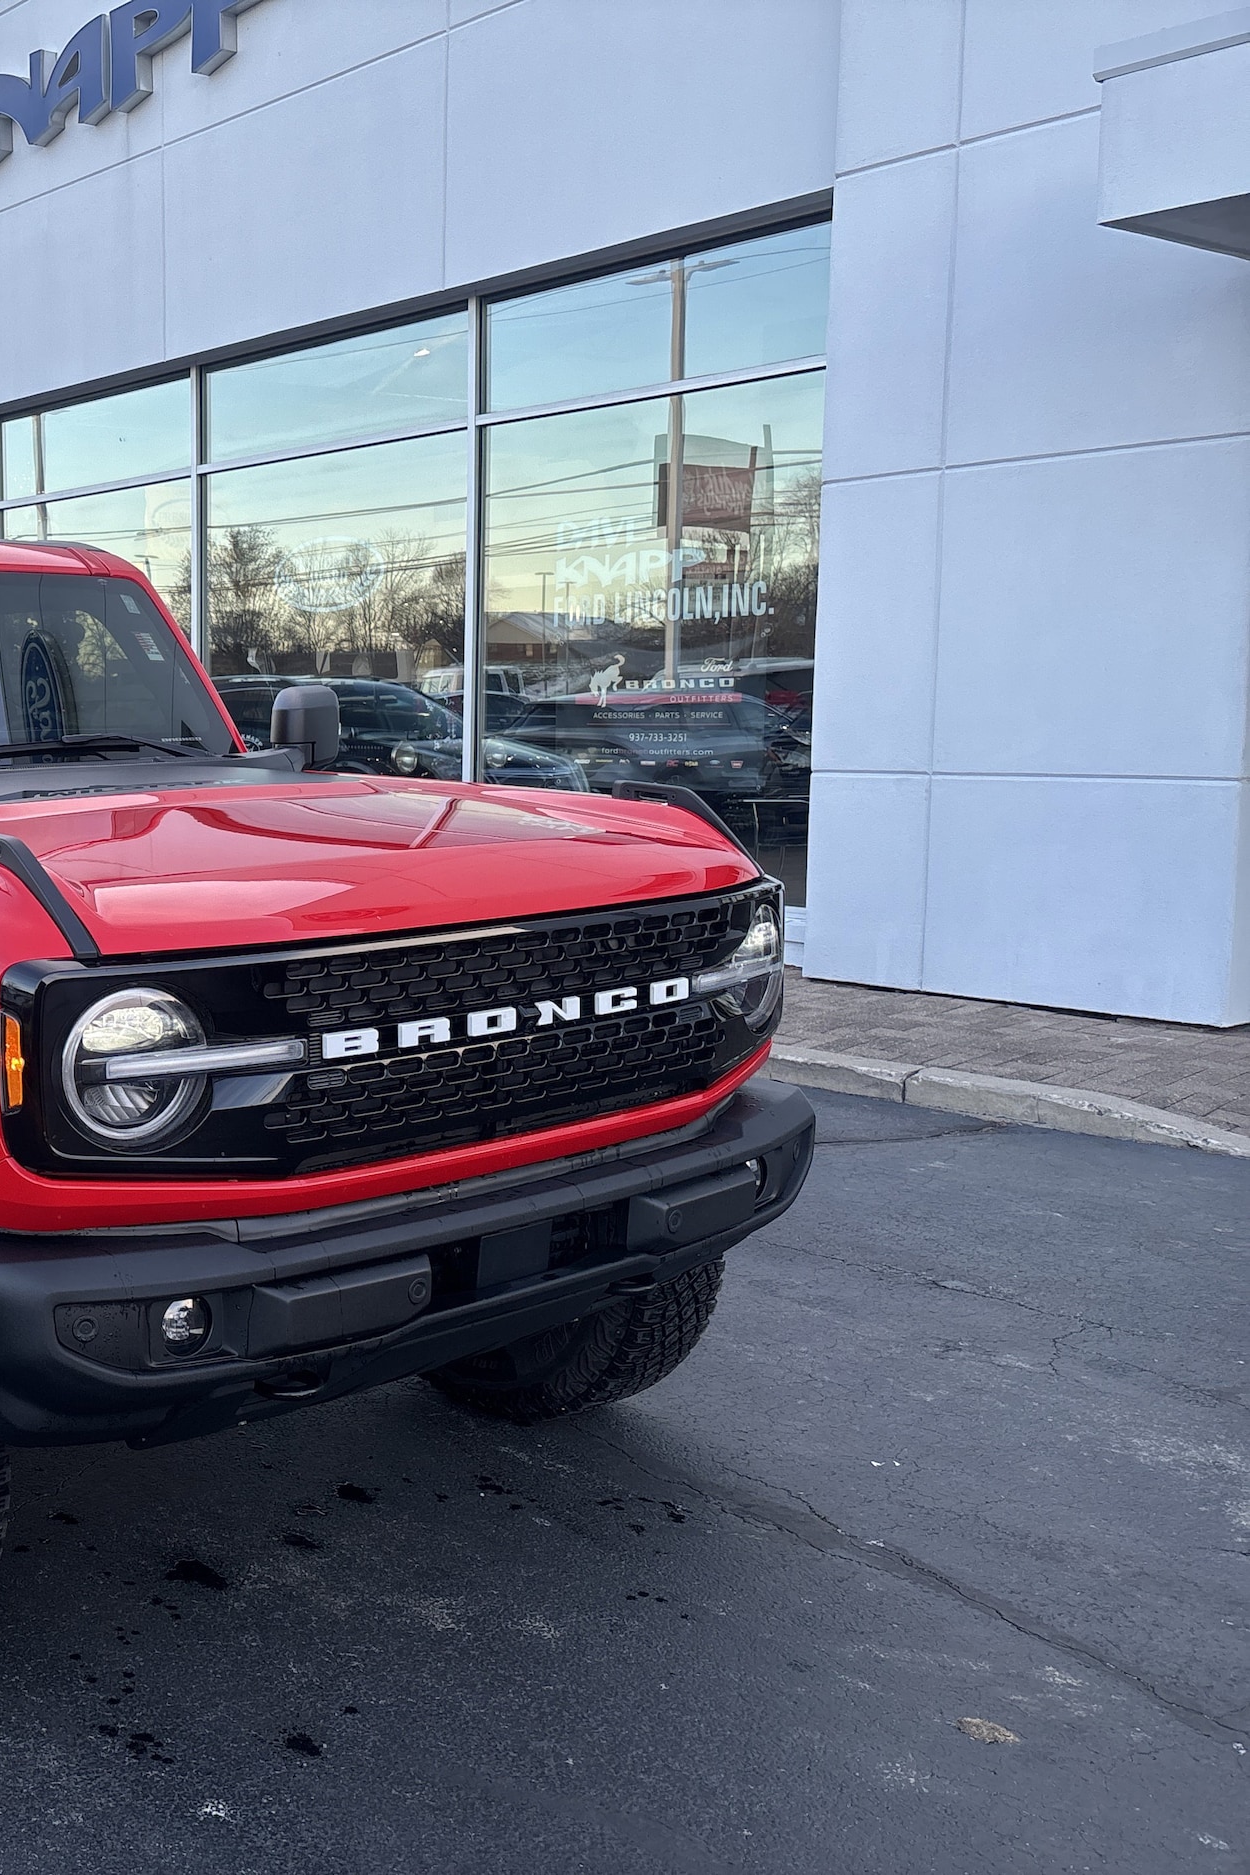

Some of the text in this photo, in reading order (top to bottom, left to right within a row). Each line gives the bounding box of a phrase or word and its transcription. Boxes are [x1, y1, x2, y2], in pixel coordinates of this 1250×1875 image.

[556, 548, 706, 590] KNAPP
[553, 593, 606, 628] FORD
[701, 657, 734, 673] Ford
[625, 677, 735, 690] BRONCO
[669, 694, 734, 703] OUTFITTERS
[690, 711, 724, 719] SERVICE
[629, 733, 687, 742] 937-733-3251
[322, 976, 690, 1060] BRONCO
